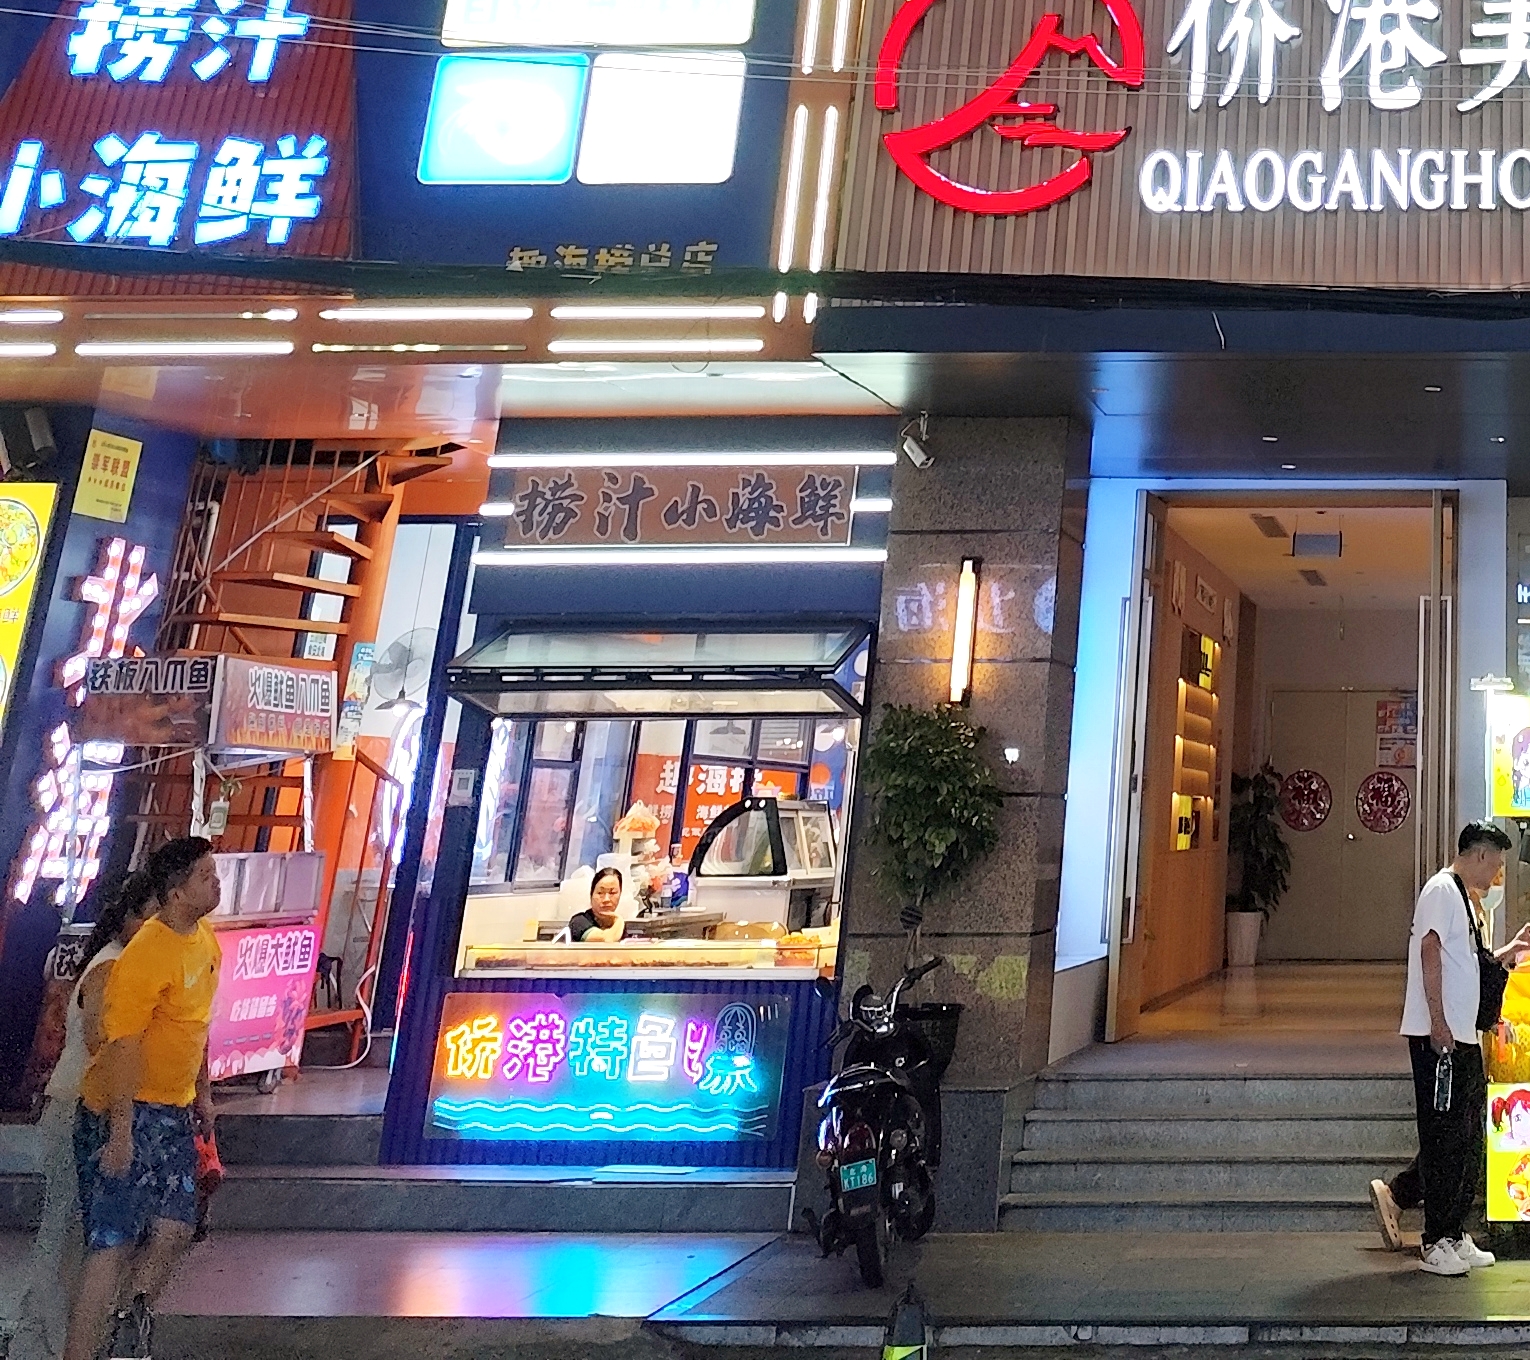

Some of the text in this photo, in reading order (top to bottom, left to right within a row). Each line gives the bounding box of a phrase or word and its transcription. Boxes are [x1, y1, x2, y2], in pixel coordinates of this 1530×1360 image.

[514, 469, 849, 543] 捞汁小海鲜
